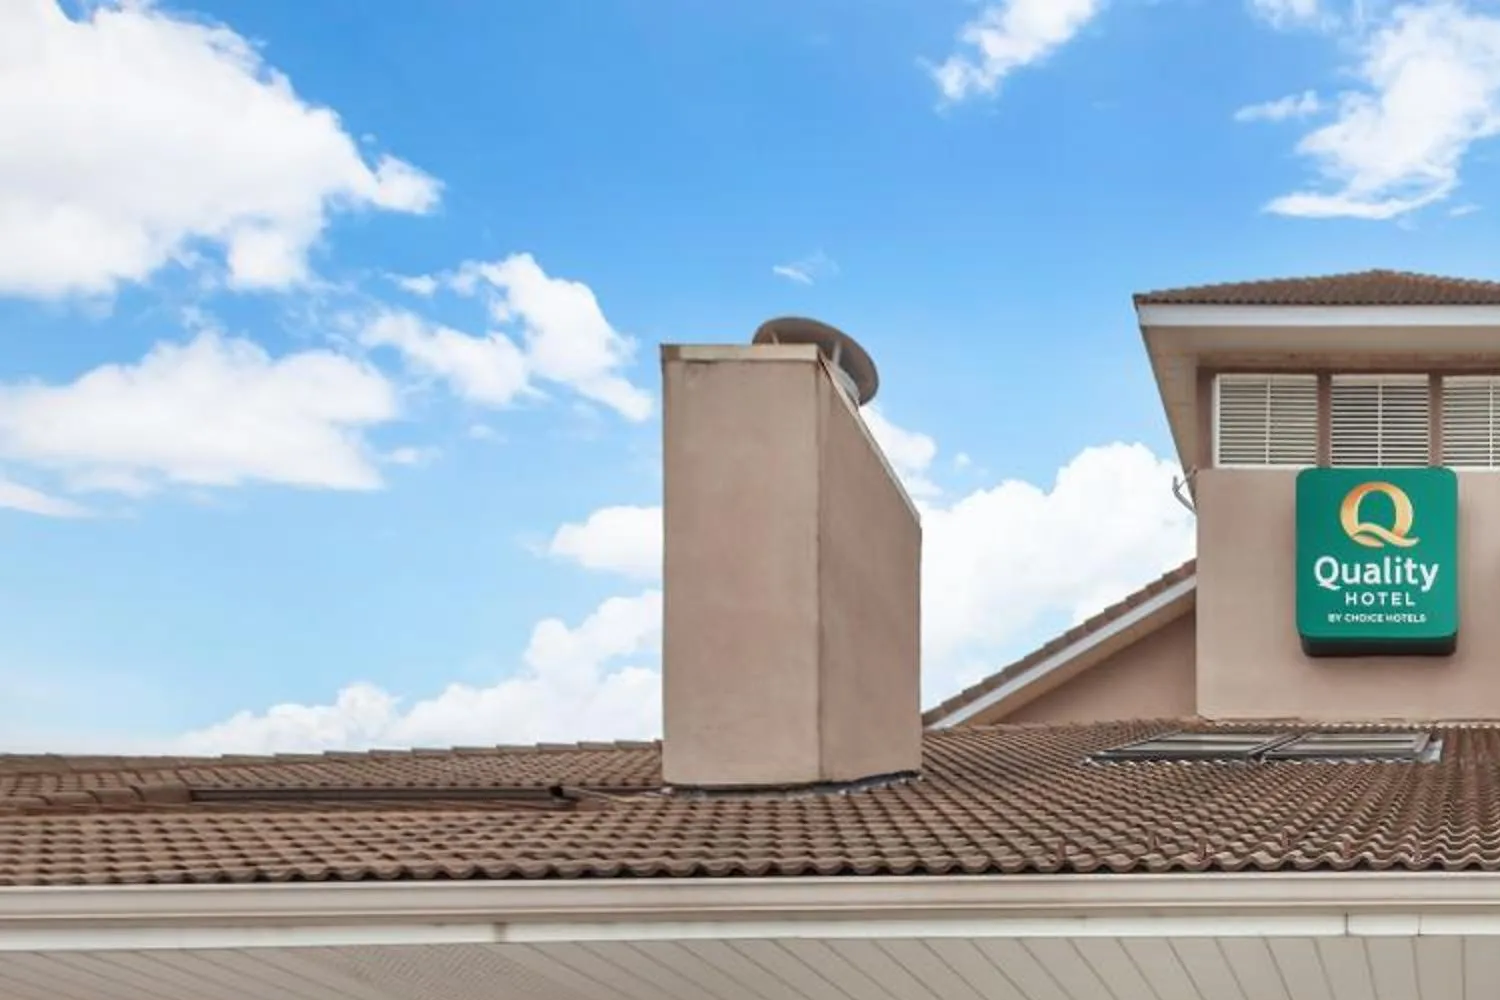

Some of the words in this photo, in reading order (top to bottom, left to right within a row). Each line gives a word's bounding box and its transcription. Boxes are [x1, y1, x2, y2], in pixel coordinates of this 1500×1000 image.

[1340, 481, 1420, 548] Q
[1314, 555, 1439, 592] Quality
[1345, 591, 1416, 606] HOTEL
[1327, 613, 1341, 623] BY
[1344, 613, 1384, 623] CHOICE
[1386, 613, 1427, 623] HOTELS
